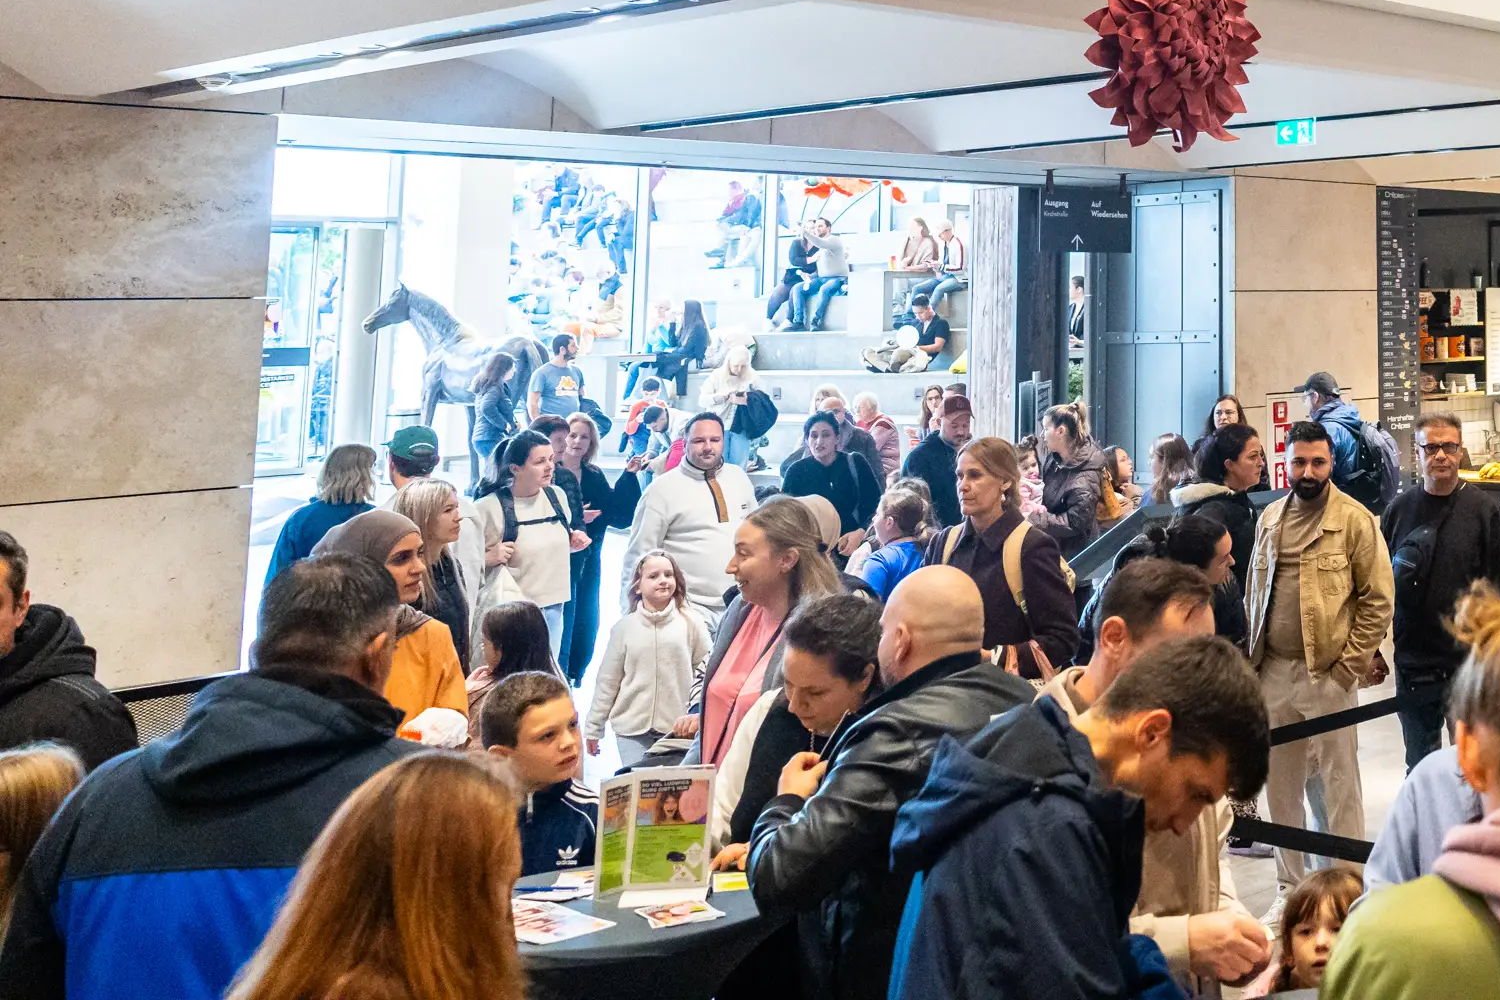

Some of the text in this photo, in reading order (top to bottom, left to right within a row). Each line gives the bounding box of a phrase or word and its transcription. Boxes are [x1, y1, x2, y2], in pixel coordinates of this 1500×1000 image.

[1044, 199, 1069, 209] Ausgang
[1091, 200, 1102, 208] Auf
[1090, 209, 1128, 219] Wiedersehen
